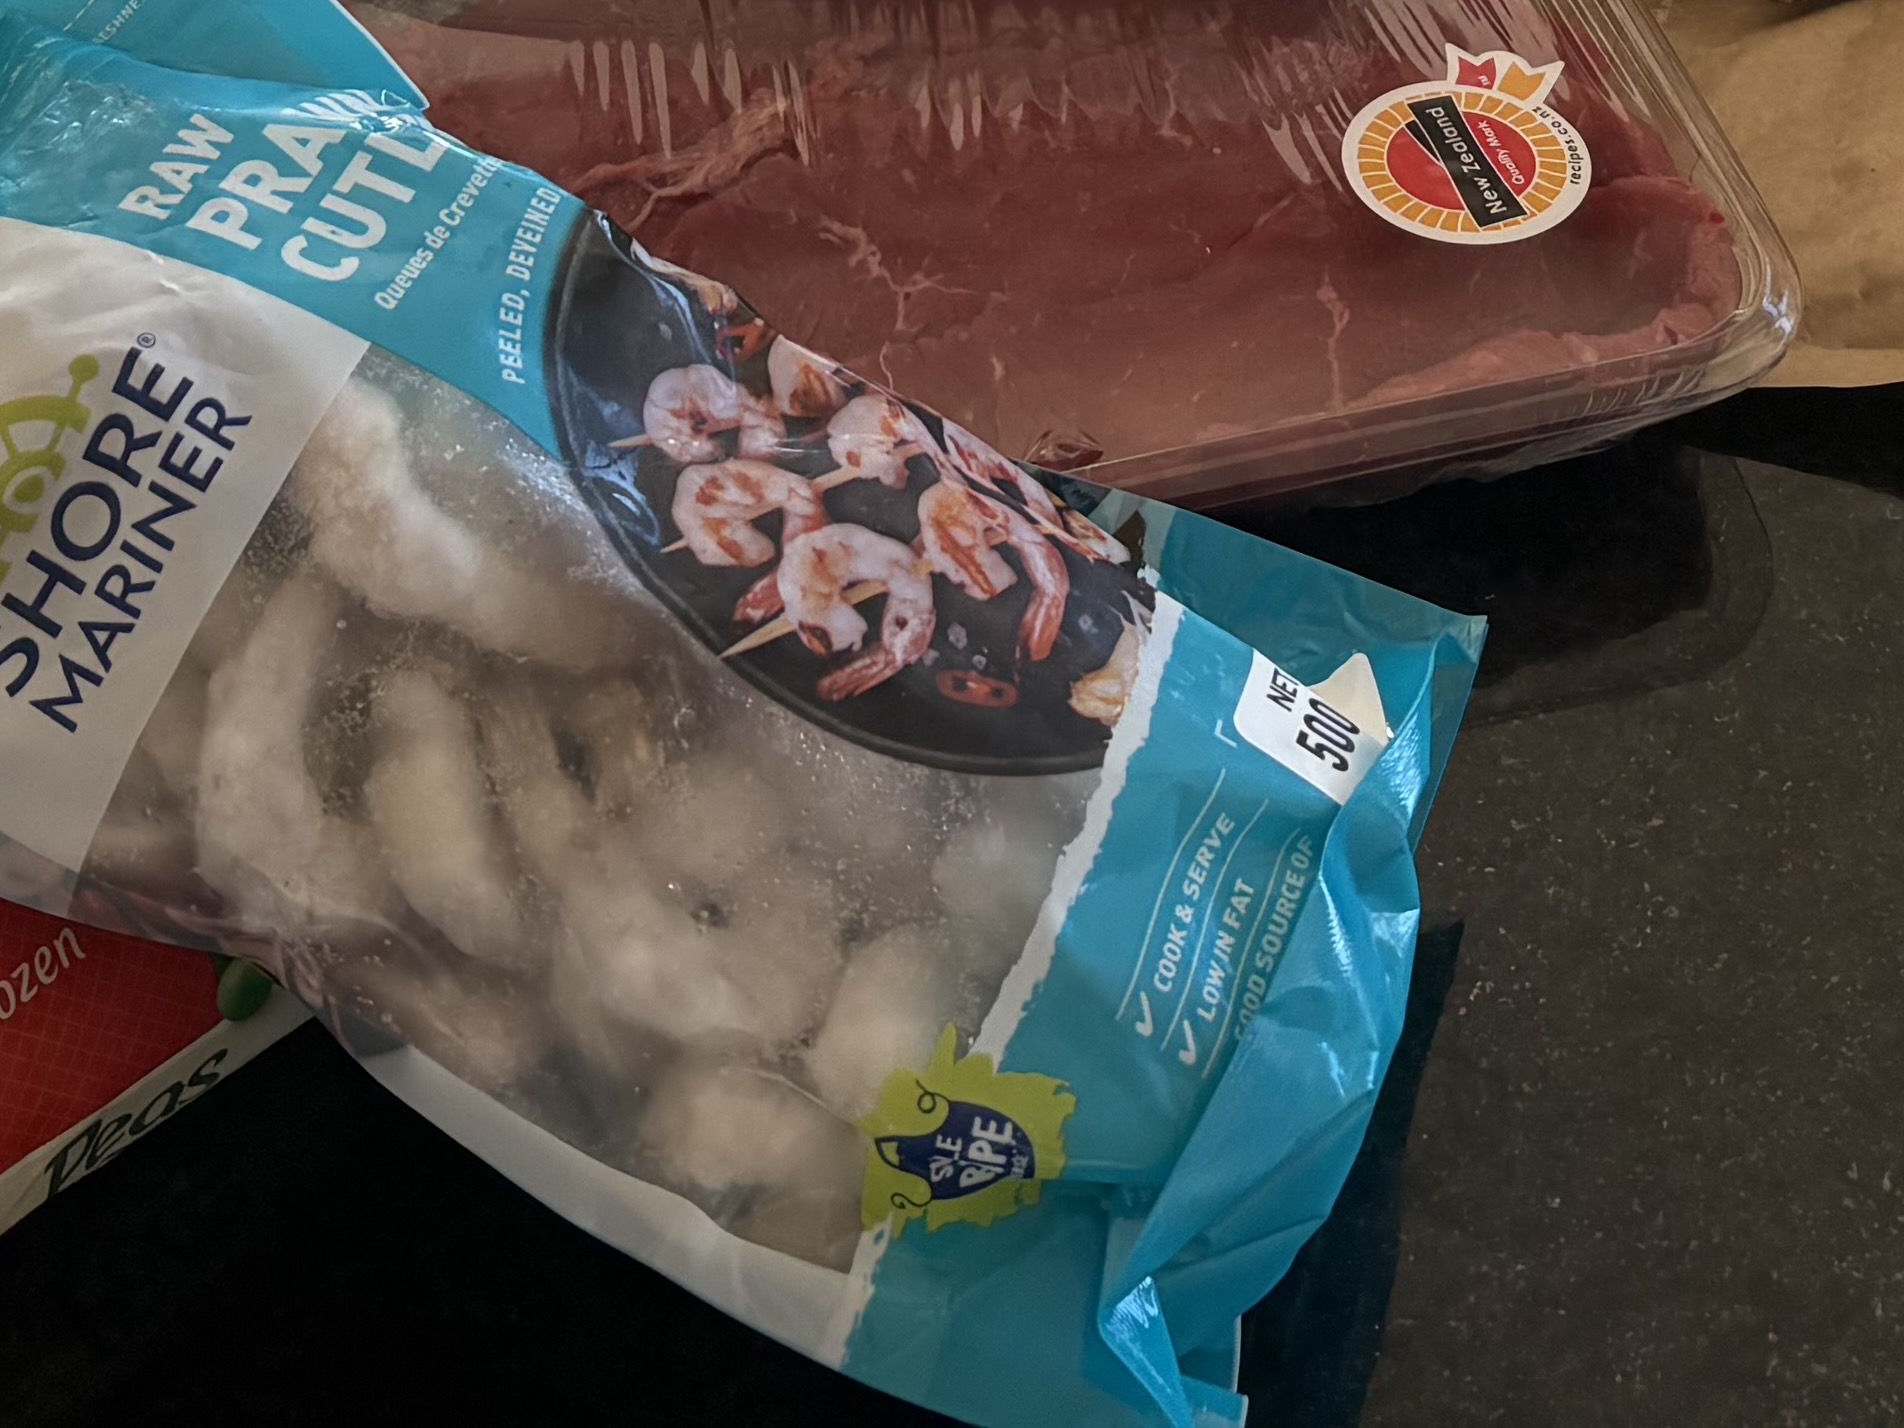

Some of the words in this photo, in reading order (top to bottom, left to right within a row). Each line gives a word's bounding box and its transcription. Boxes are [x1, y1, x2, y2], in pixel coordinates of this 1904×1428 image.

[118, 112, 236, 223] RAW
[1424, 105, 1482, 174] Zealand
[1477, 118, 1502, 148] Mark
[1496, 148, 1525, 186] Quality
[1531, 104, 1585, 186] recipes.co.nz
[280, 128, 451, 284] CUTL
[1473, 175, 1508, 215] New
[374, 246, 435, 311] Queues
[424, 224, 451, 251] de
[505, 186, 563, 282] DEVEINED
[498, 288, 531, 386] PEELED,
[28, 396, 253, 735] MARINER
[1265, 666, 1300, 714] NET
[1296, 698, 1363, 774] 500
[1182, 811, 1236, 901] SERVE
[1174, 903, 1196, 925] &
[1222, 876, 1255, 932] FAT
[1254, 868, 1306, 974] SOURCE
[1152, 923, 1189, 993] COOK
[1211, 929, 1237, 965] IN
[1196, 965, 1227, 1024] LOW
[44, 1047, 230, 1202] Peas
